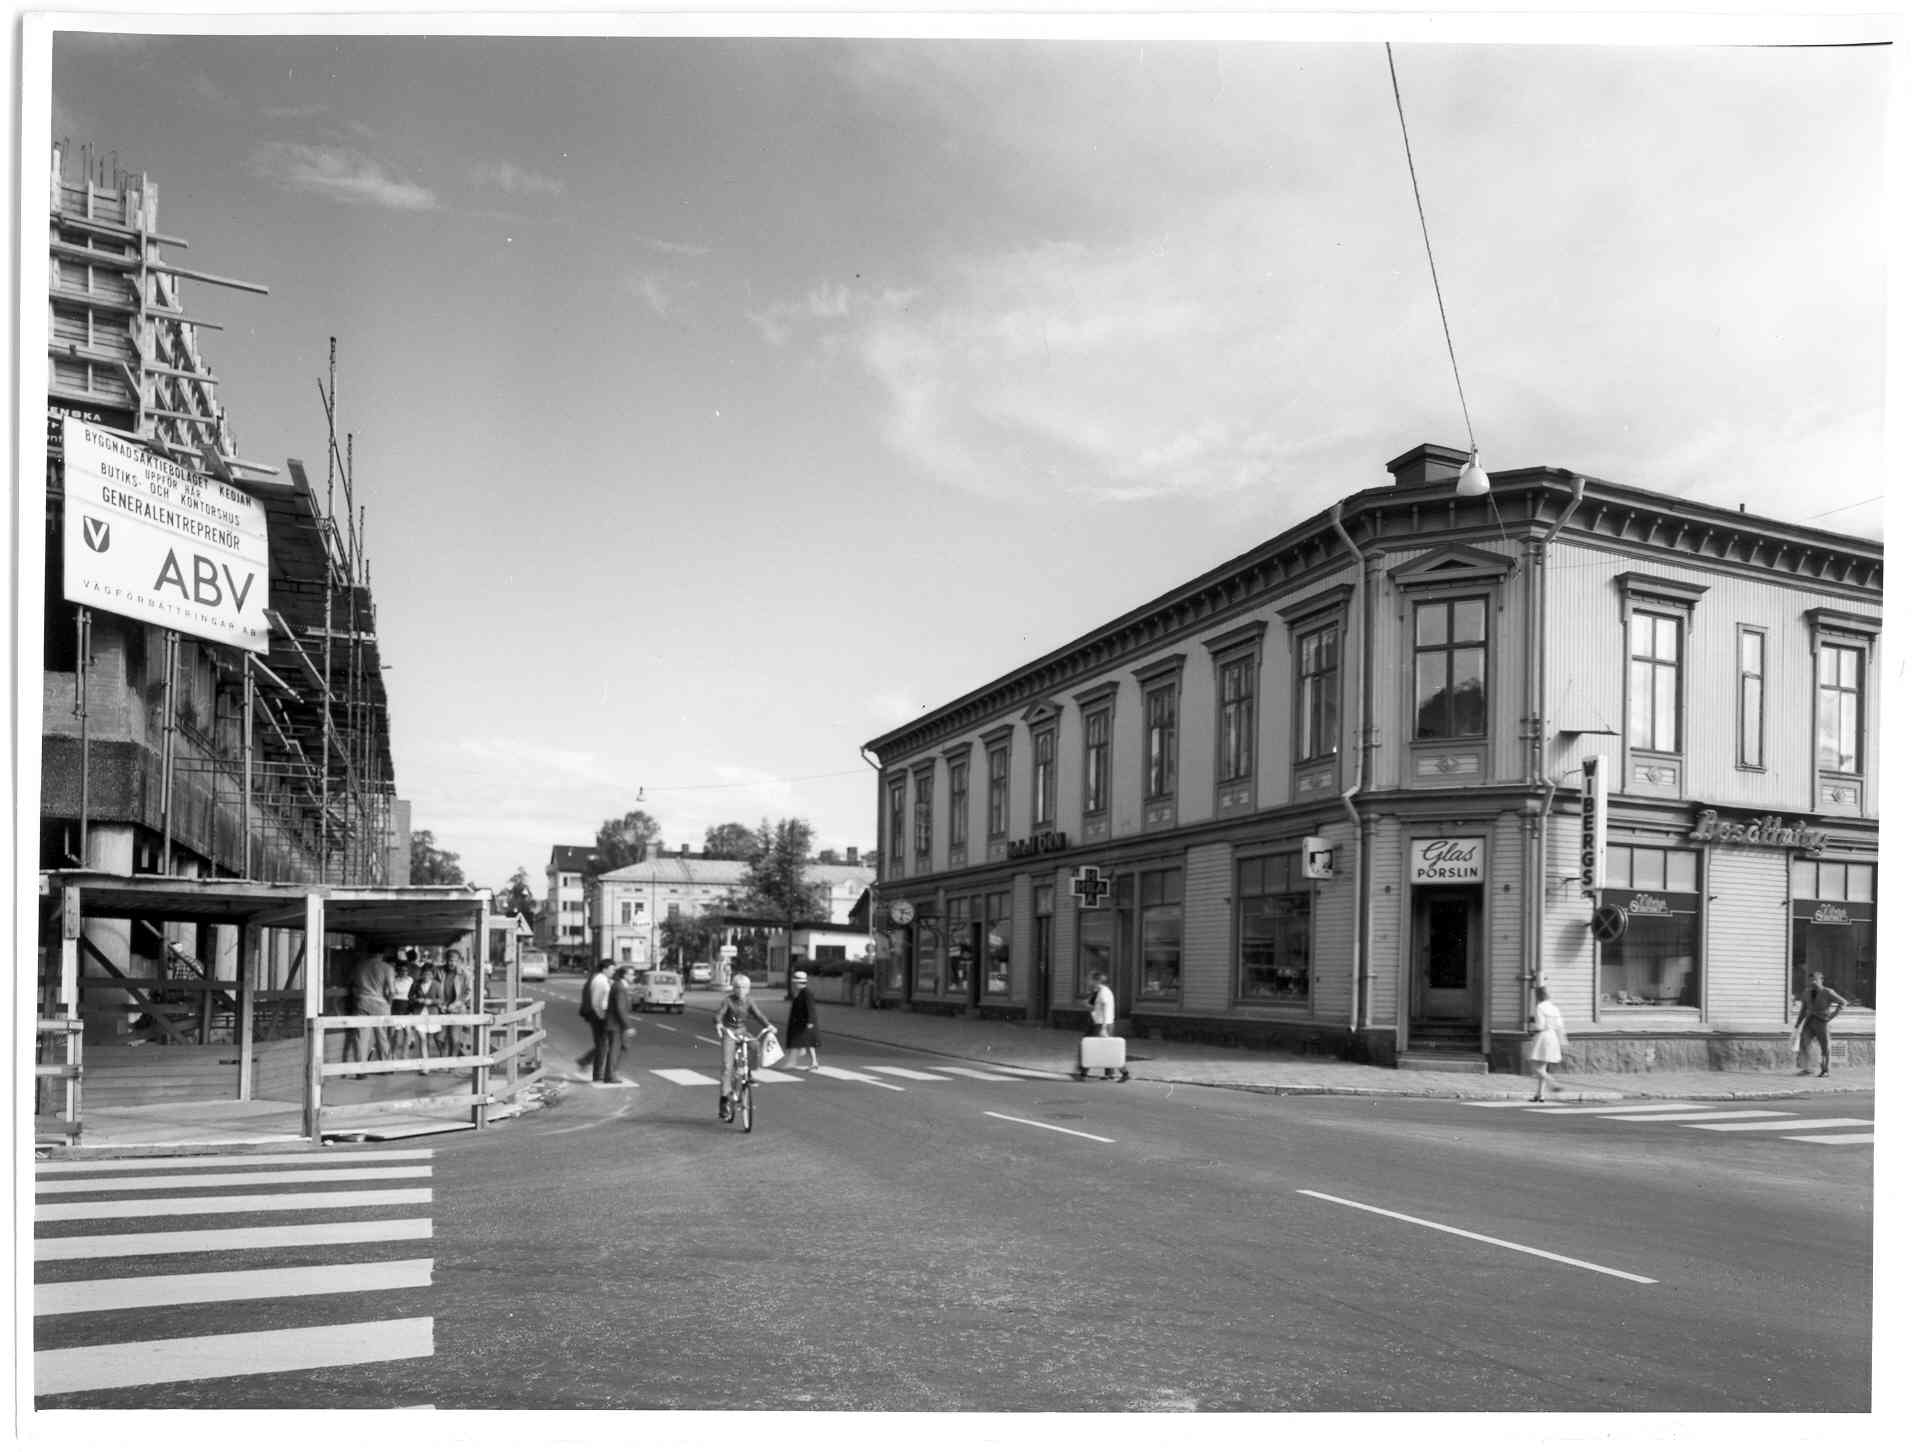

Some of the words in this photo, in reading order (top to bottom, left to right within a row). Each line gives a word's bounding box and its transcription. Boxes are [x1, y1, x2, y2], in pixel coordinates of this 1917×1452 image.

[102, 485, 241, 551] GENERALENTREPRENÖR
[150, 482, 170, 498] OCH
[181, 494, 241, 527] KONTORSHUS
[153, 546, 256, 614] ABV
[1582, 759, 1597, 886] WIBERGS
[1417, 867, 1479, 879] PORSLIN
[1421, 840, 1478, 868] Glas
